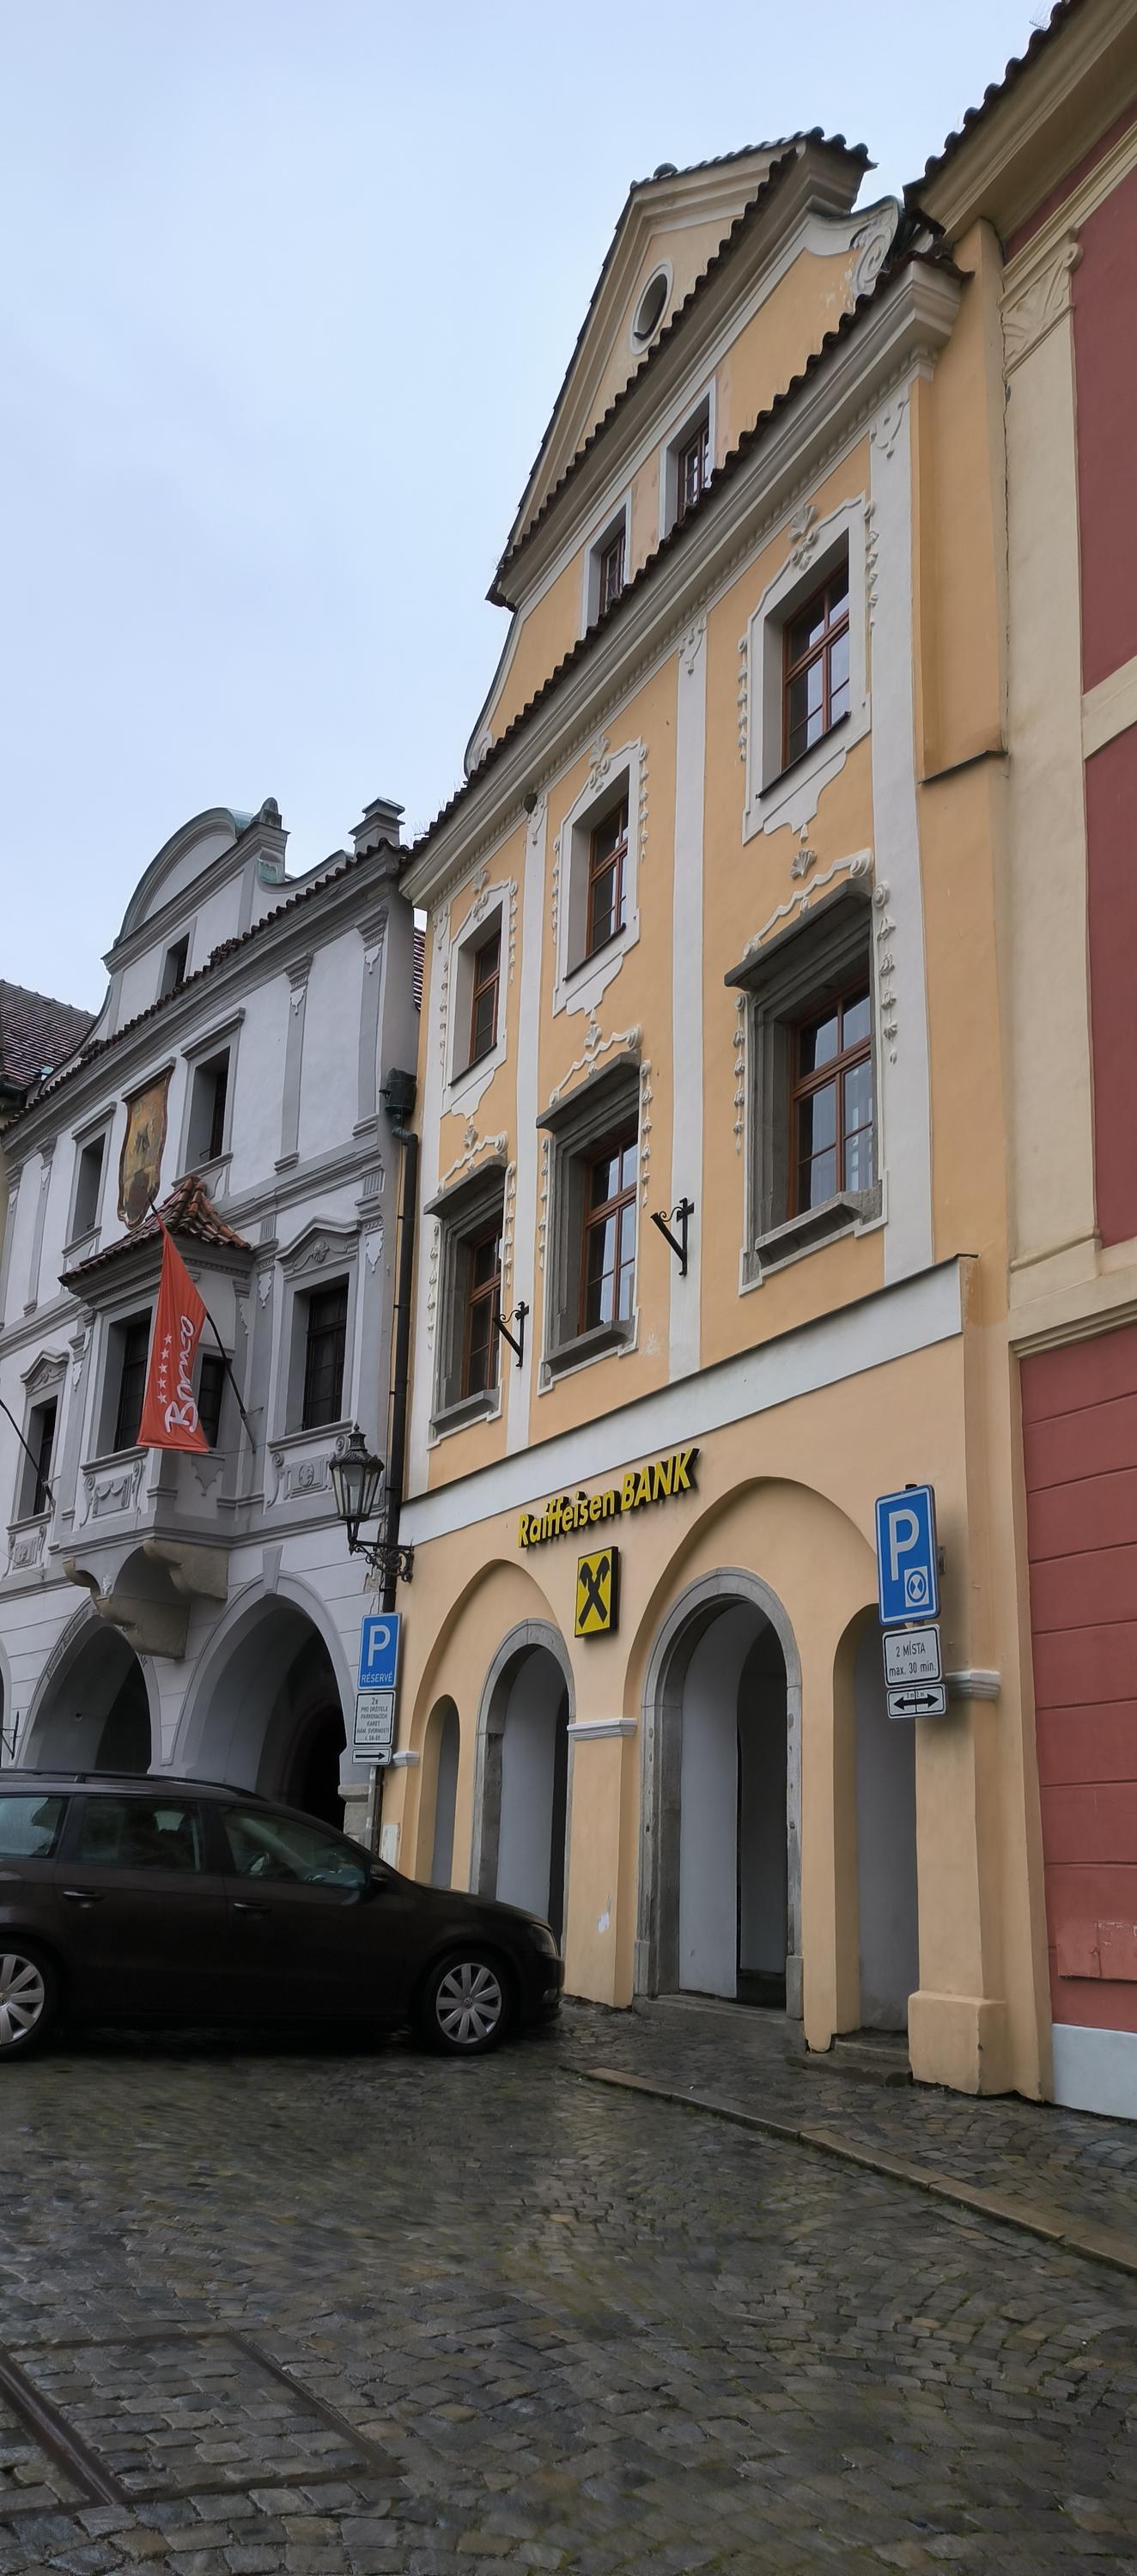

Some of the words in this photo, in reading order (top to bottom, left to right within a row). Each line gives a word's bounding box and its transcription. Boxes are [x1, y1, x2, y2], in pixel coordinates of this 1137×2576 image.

[519, 1491, 620, 1548] Raiffeisen
[621, 1449, 700, 1511] BANK
[888, 1509, 920, 1581] P
[368, 1625, 391, 1667] P
[896, 1646, 900, 1657] 2
[903, 1641, 926, 1656] MÍSTA
[361, 1671, 392, 1683] RÉSERVÉ
[889, 1667, 906, 1677] max.
[909, 1662, 917, 1674] 30
[921, 1661, 936, 1673] min.
